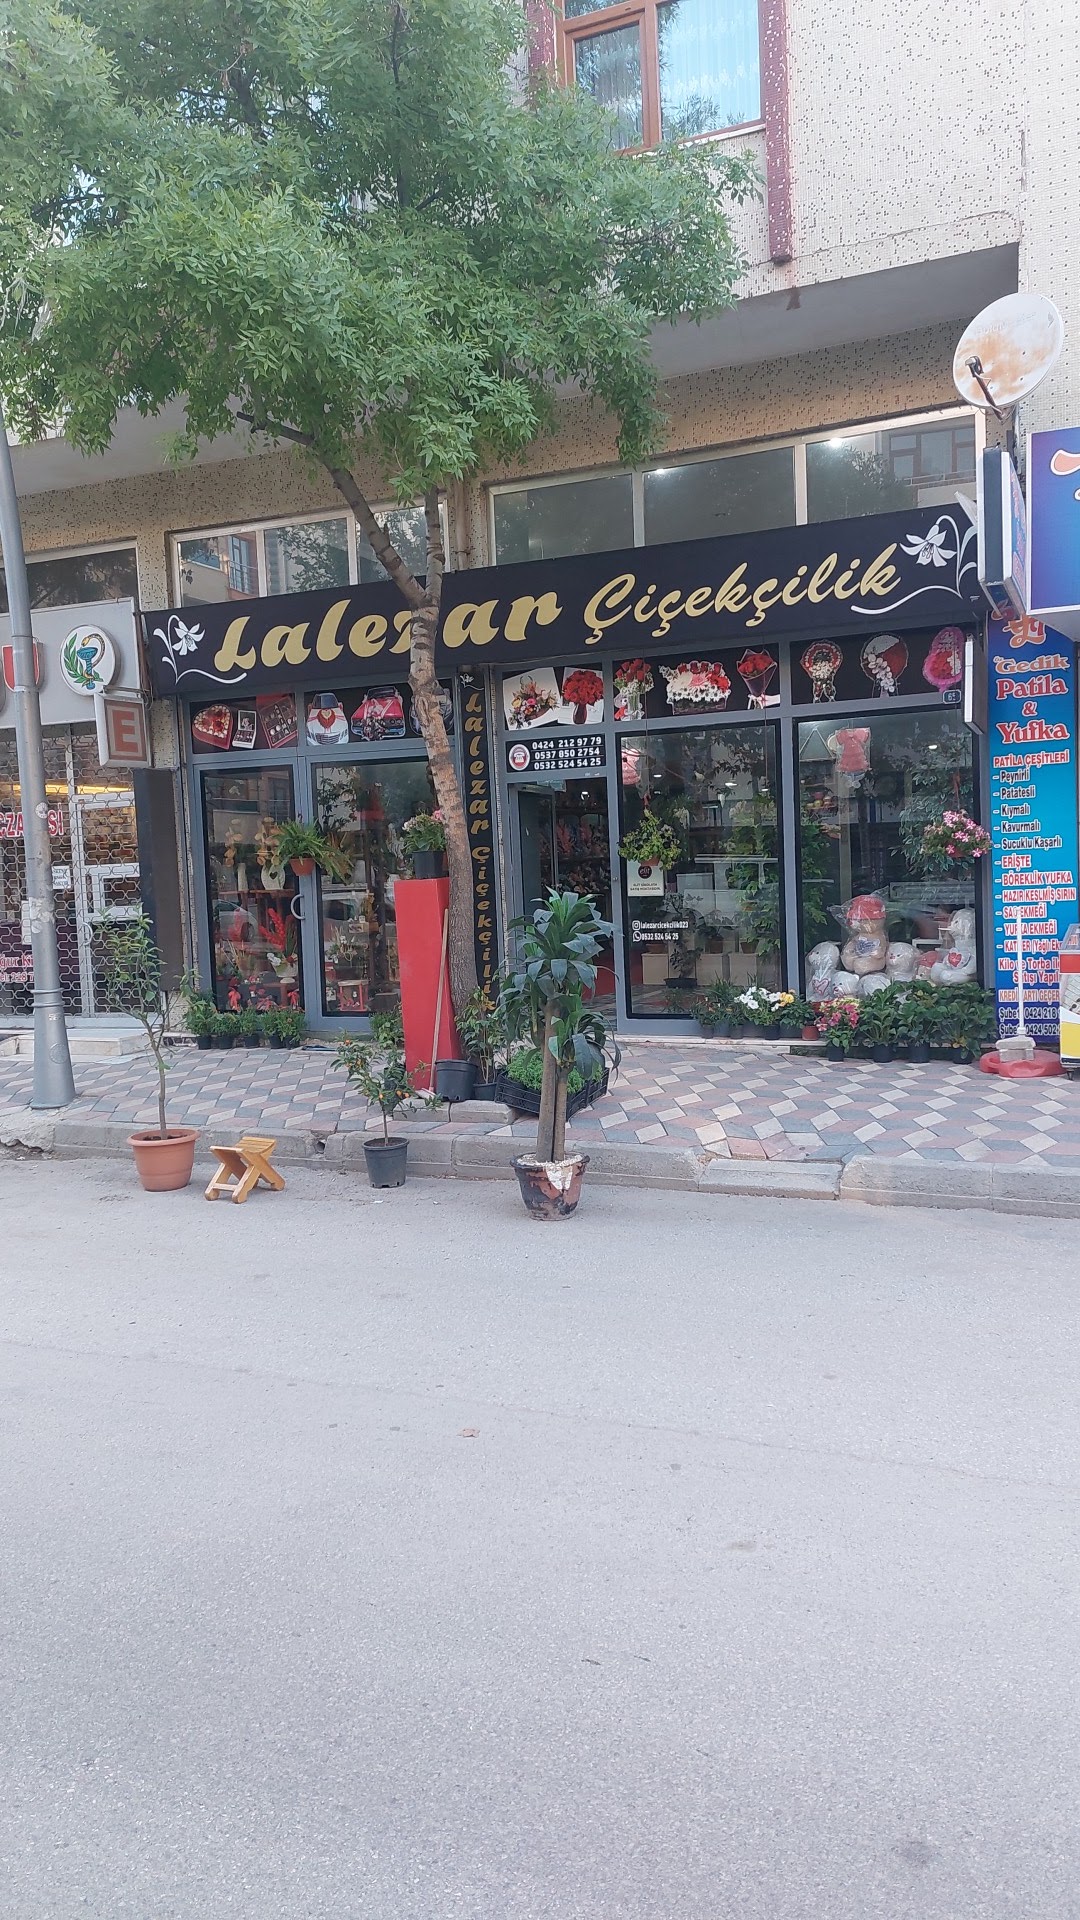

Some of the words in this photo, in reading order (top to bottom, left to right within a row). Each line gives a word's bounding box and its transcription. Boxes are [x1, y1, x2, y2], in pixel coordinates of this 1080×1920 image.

[584, 543, 901, 645] Çiçekçilik
[995, 654, 1070, 674] Gedik
[996, 674, 1068, 700] Patila
[1022, 701, 1037, 716] &
[112, 709, 139, 753] E
[996, 719, 1070, 744] Yufka
[532, 741, 554, 750] 0424
[558, 739, 575, 748] 212
[577, 737, 588, 746] 97
[590, 736, 602, 745] 79
[534, 751, 556, 760] 0537
[559, 749, 575, 758] 850
[577, 747, 600, 757] 2754
[994, 754, 1024, 768] PATİLA
[1024, 749, 1069, 768] ÇEŞİTLERİ
[464, 693, 490, 834] Lalezar
[534, 761, 556, 770] 0532
[558, 760, 575, 769] 524
[577, 758, 588, 767] 54
[590, 757, 602, 766] 25
[1000, 768, 1030, 785] Peynirli
[1001, 785, 1036, 799] Patatesli
[1001, 803, 1030, 818] Kıymalı
[1001, 819, 1041, 833] Kavurmalı
[1002, 837, 1033, 850] Sucuklu
[1033, 835, 1062, 850] Kaşarlı
[1002, 853, 1031, 871] ERİŞTE
[1002, 870, 1045, 886] BÖREKLİK
[1045, 871, 1073, 884] YUFKA
[1002, 890, 1024, 903] HAZIR
[471, 846, 497, 1012] Çiçekçilik
[1029, 919, 1057, 935] EKMEĞİ
[1004, 940, 1030, 952] KATER
[998, 958, 1015, 970] Kilo
[1027, 957, 1051, 970] Torba
[1013, 971, 1037, 986] Stışı
[1019, 990, 1038, 1002] ARTI
[1024, 1007, 1042, 1019] 0424
[1043, 1007, 1057, 1019] 218
